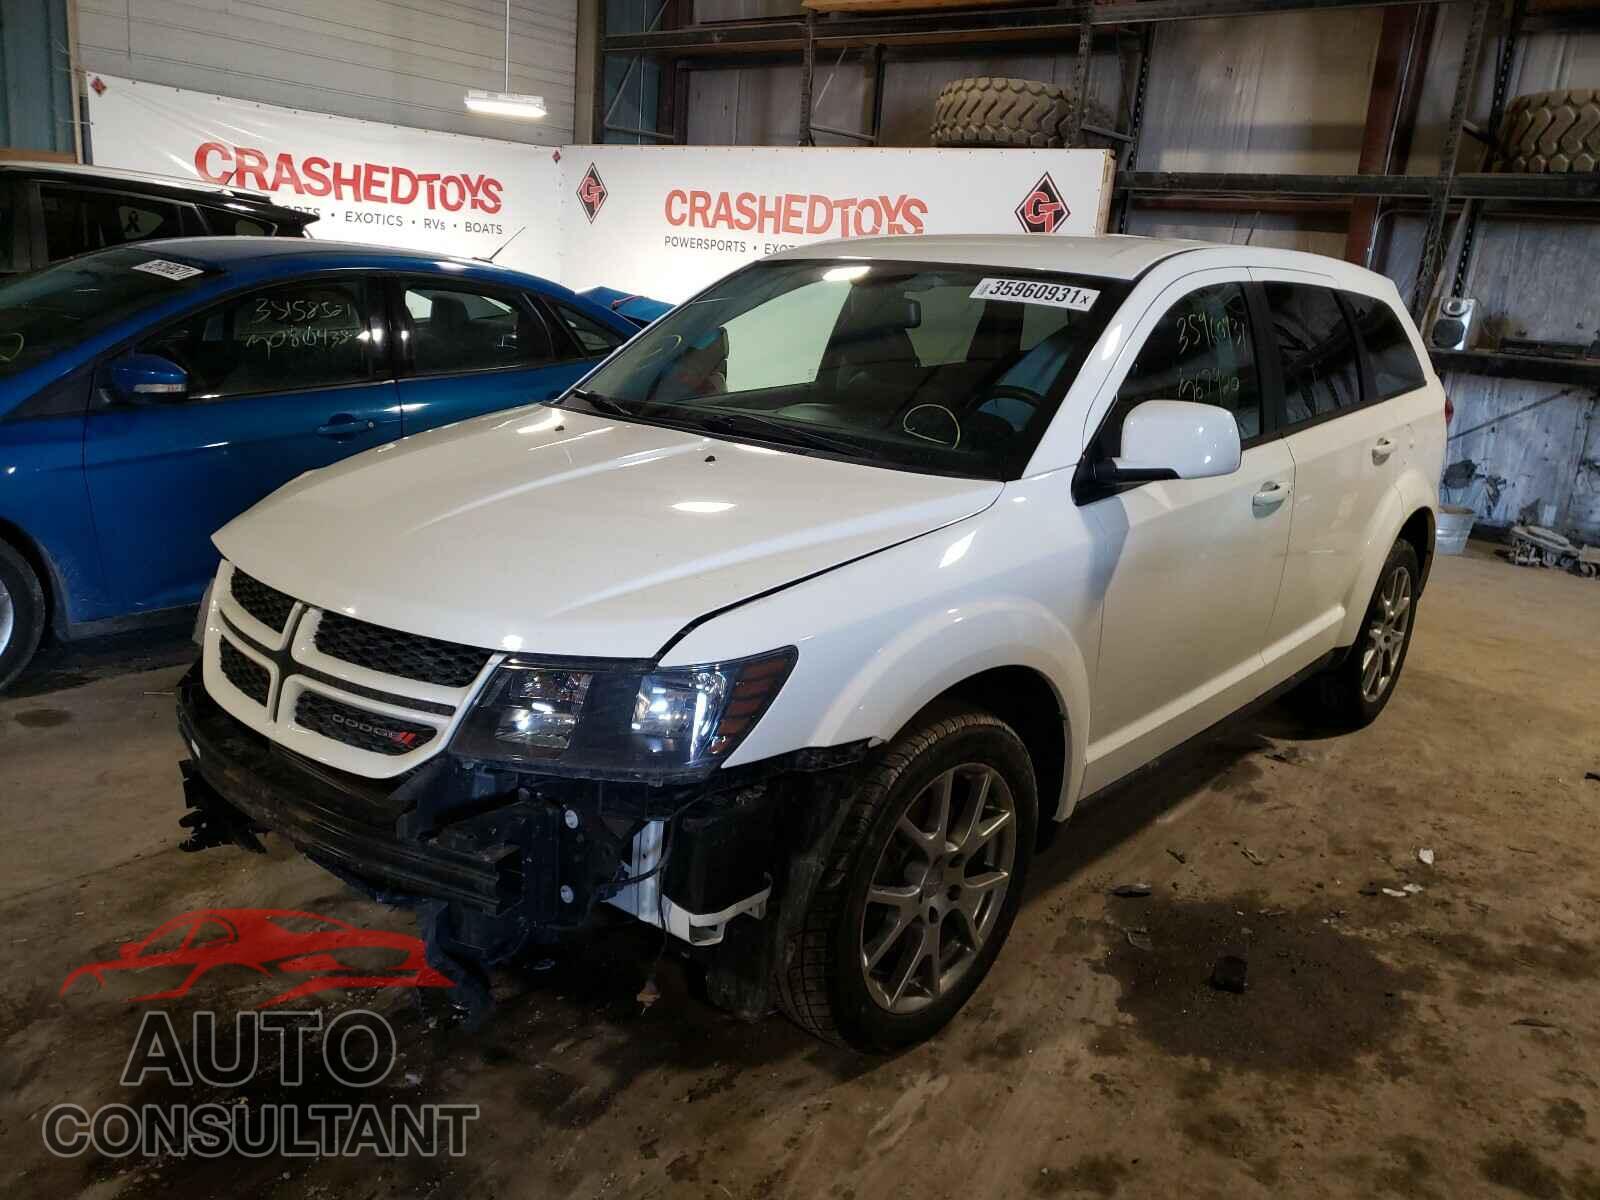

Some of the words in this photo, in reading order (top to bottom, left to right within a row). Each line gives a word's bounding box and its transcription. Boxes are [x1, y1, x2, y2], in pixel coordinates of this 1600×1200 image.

[195, 142, 503, 215] CRASHEDTOYS
[345, 210, 404, 227] EXOTICS
[423, 218, 446, 231] RVs
[464, 221, 503, 235] BOATS
[665, 189, 928, 238] CRASHEDTOYS
[664, 235, 747, 253] POWERSPORTS
[988, 280, 1081, 304] 35960931
